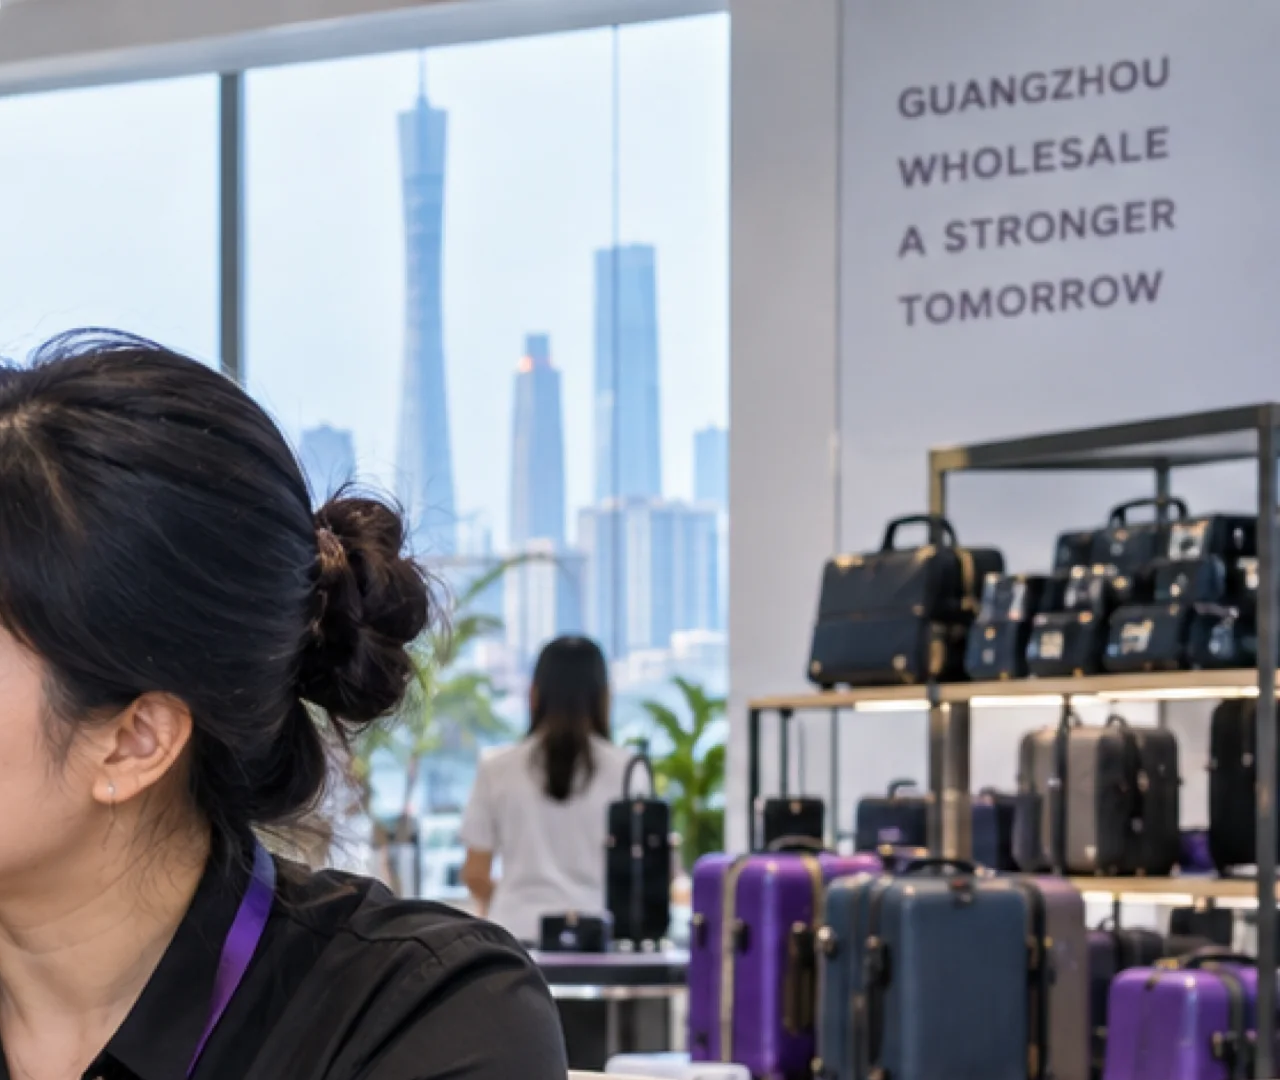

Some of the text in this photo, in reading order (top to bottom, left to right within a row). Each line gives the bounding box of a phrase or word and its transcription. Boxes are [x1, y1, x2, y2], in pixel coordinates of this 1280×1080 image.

[896, 55, 1171, 120] GUANGZHOU
[897, 125, 1171, 189] WHOLESALE
[897, 197, 1177, 260] A STRONGER
[897, 268, 1164, 327] TOMORROW
